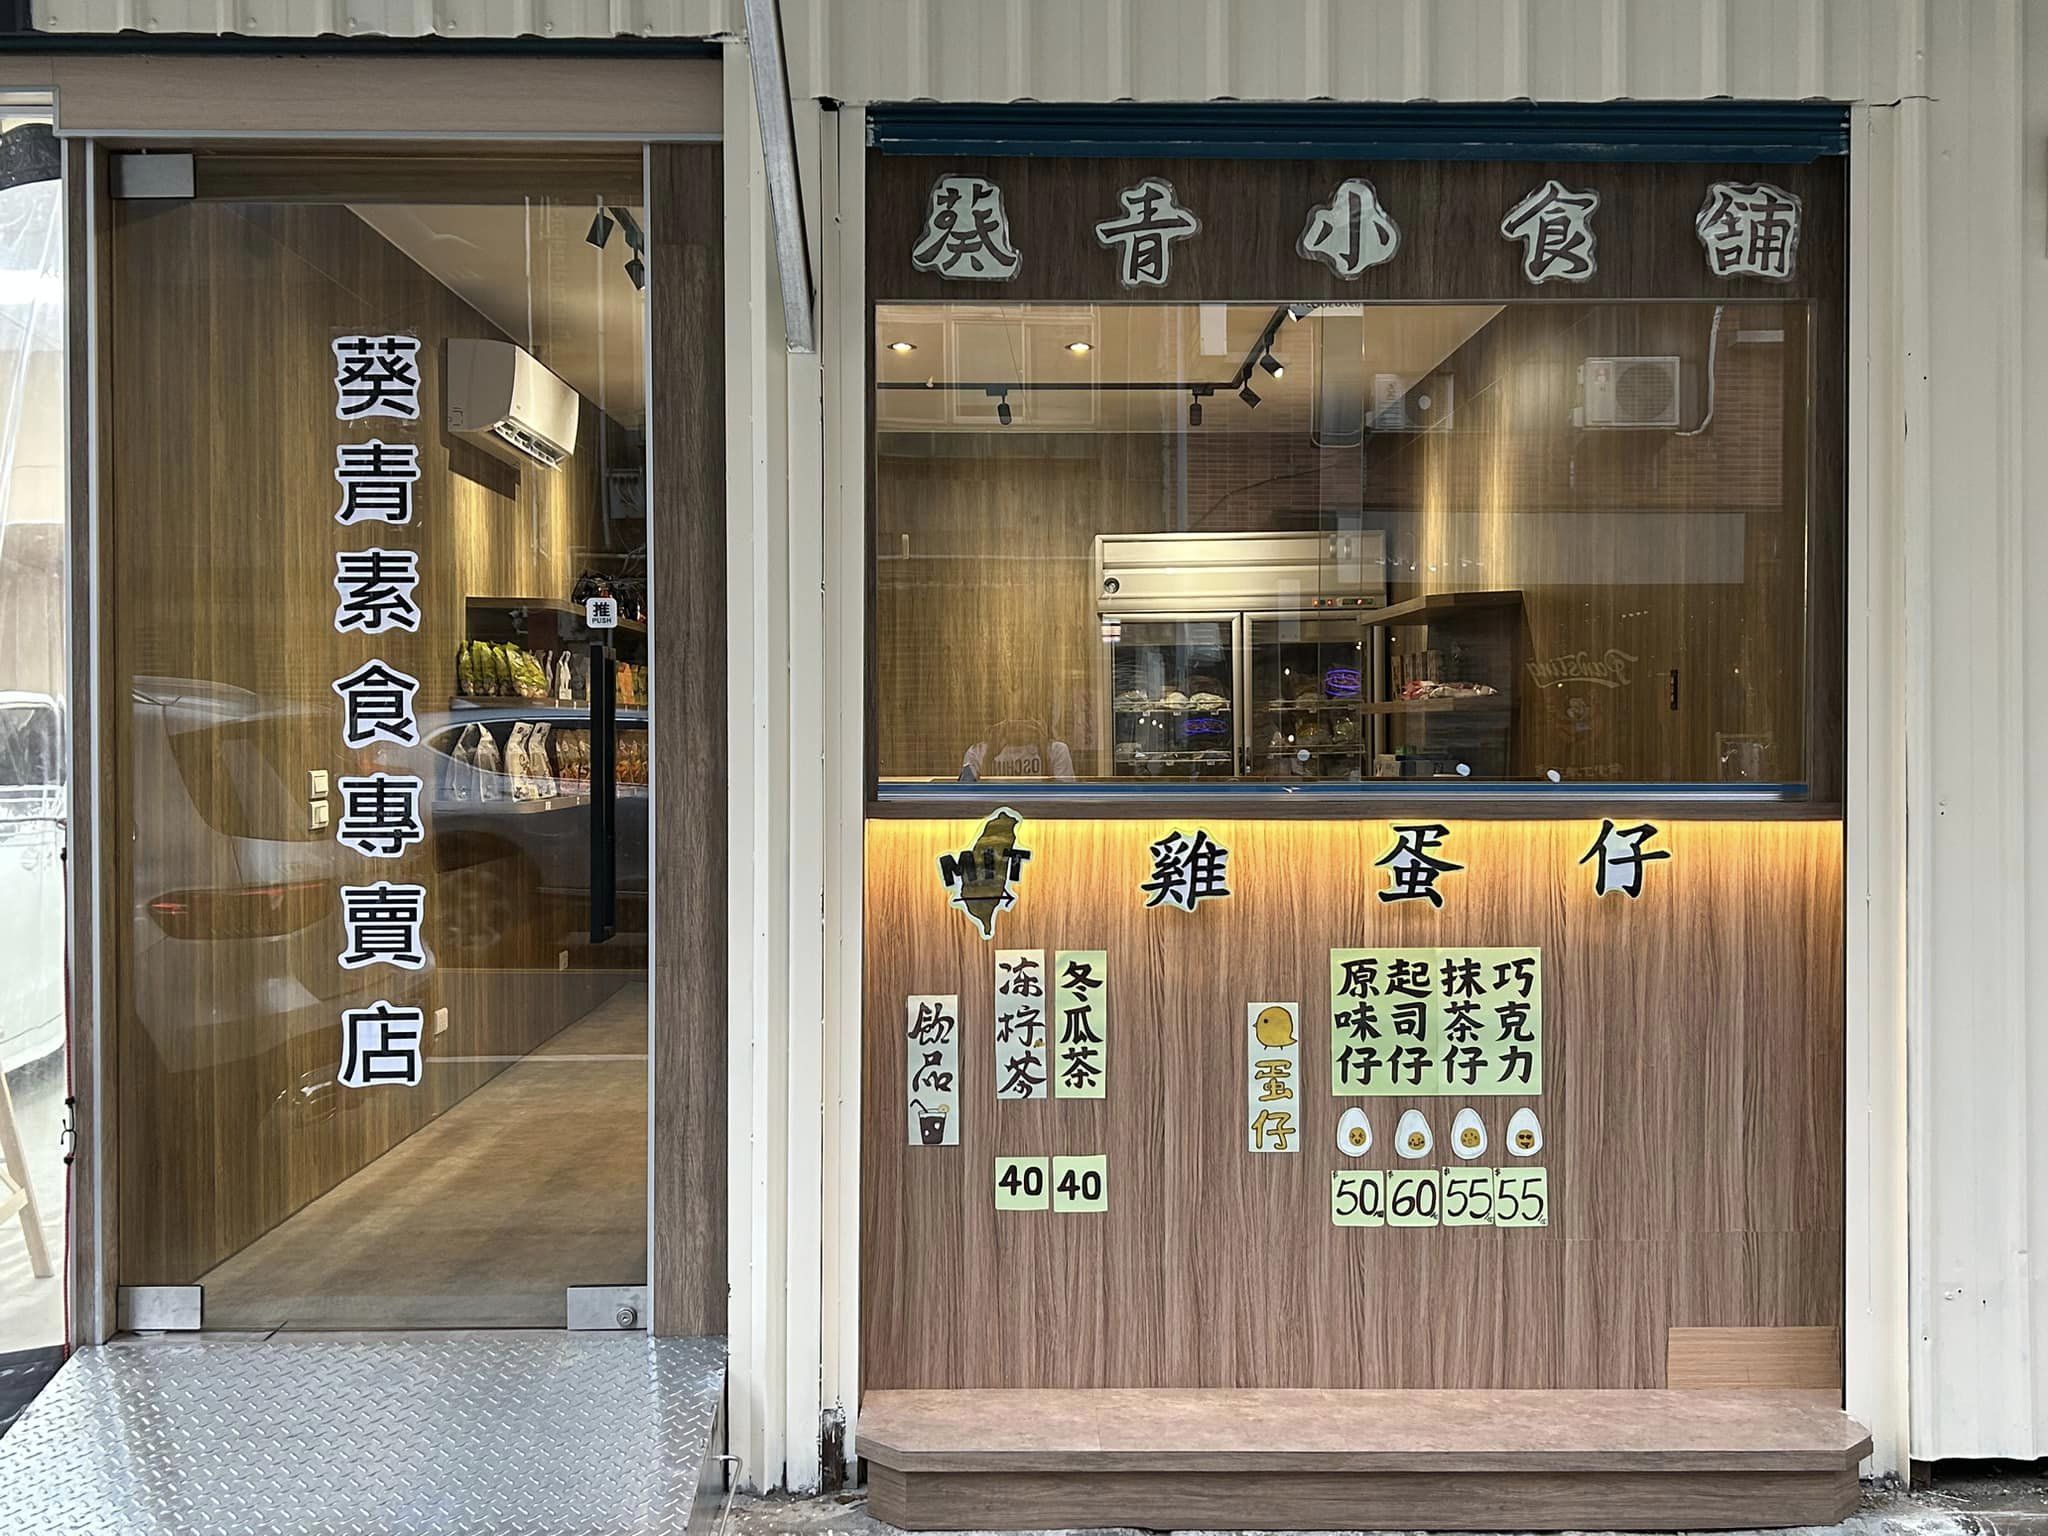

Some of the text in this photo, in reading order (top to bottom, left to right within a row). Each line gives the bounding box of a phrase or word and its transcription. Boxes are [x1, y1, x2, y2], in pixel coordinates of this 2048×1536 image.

[593, 602, 610, 617] 推
[335, 336, 424, 1084] 葵青素食專賣店
[1141, 818, 1671, 912] 雞蛋仔
[908, 1002, 955, 1092] 飲品
[1060, 960, 1104, 1089] 冬瓜茶
[1334, 957, 1382, 1085] 原味仔
[1386, 957, 1433, 1085] 起司仔
[1440, 957, 1488, 1085] 抹茶仔
[1492, 957, 1535, 1084] 巧克力
[1251, 1058, 1296, 1150] 蛋仔
[998, 1164, 1043, 1196] 40
[1057, 1169, 1101, 1201] 40
